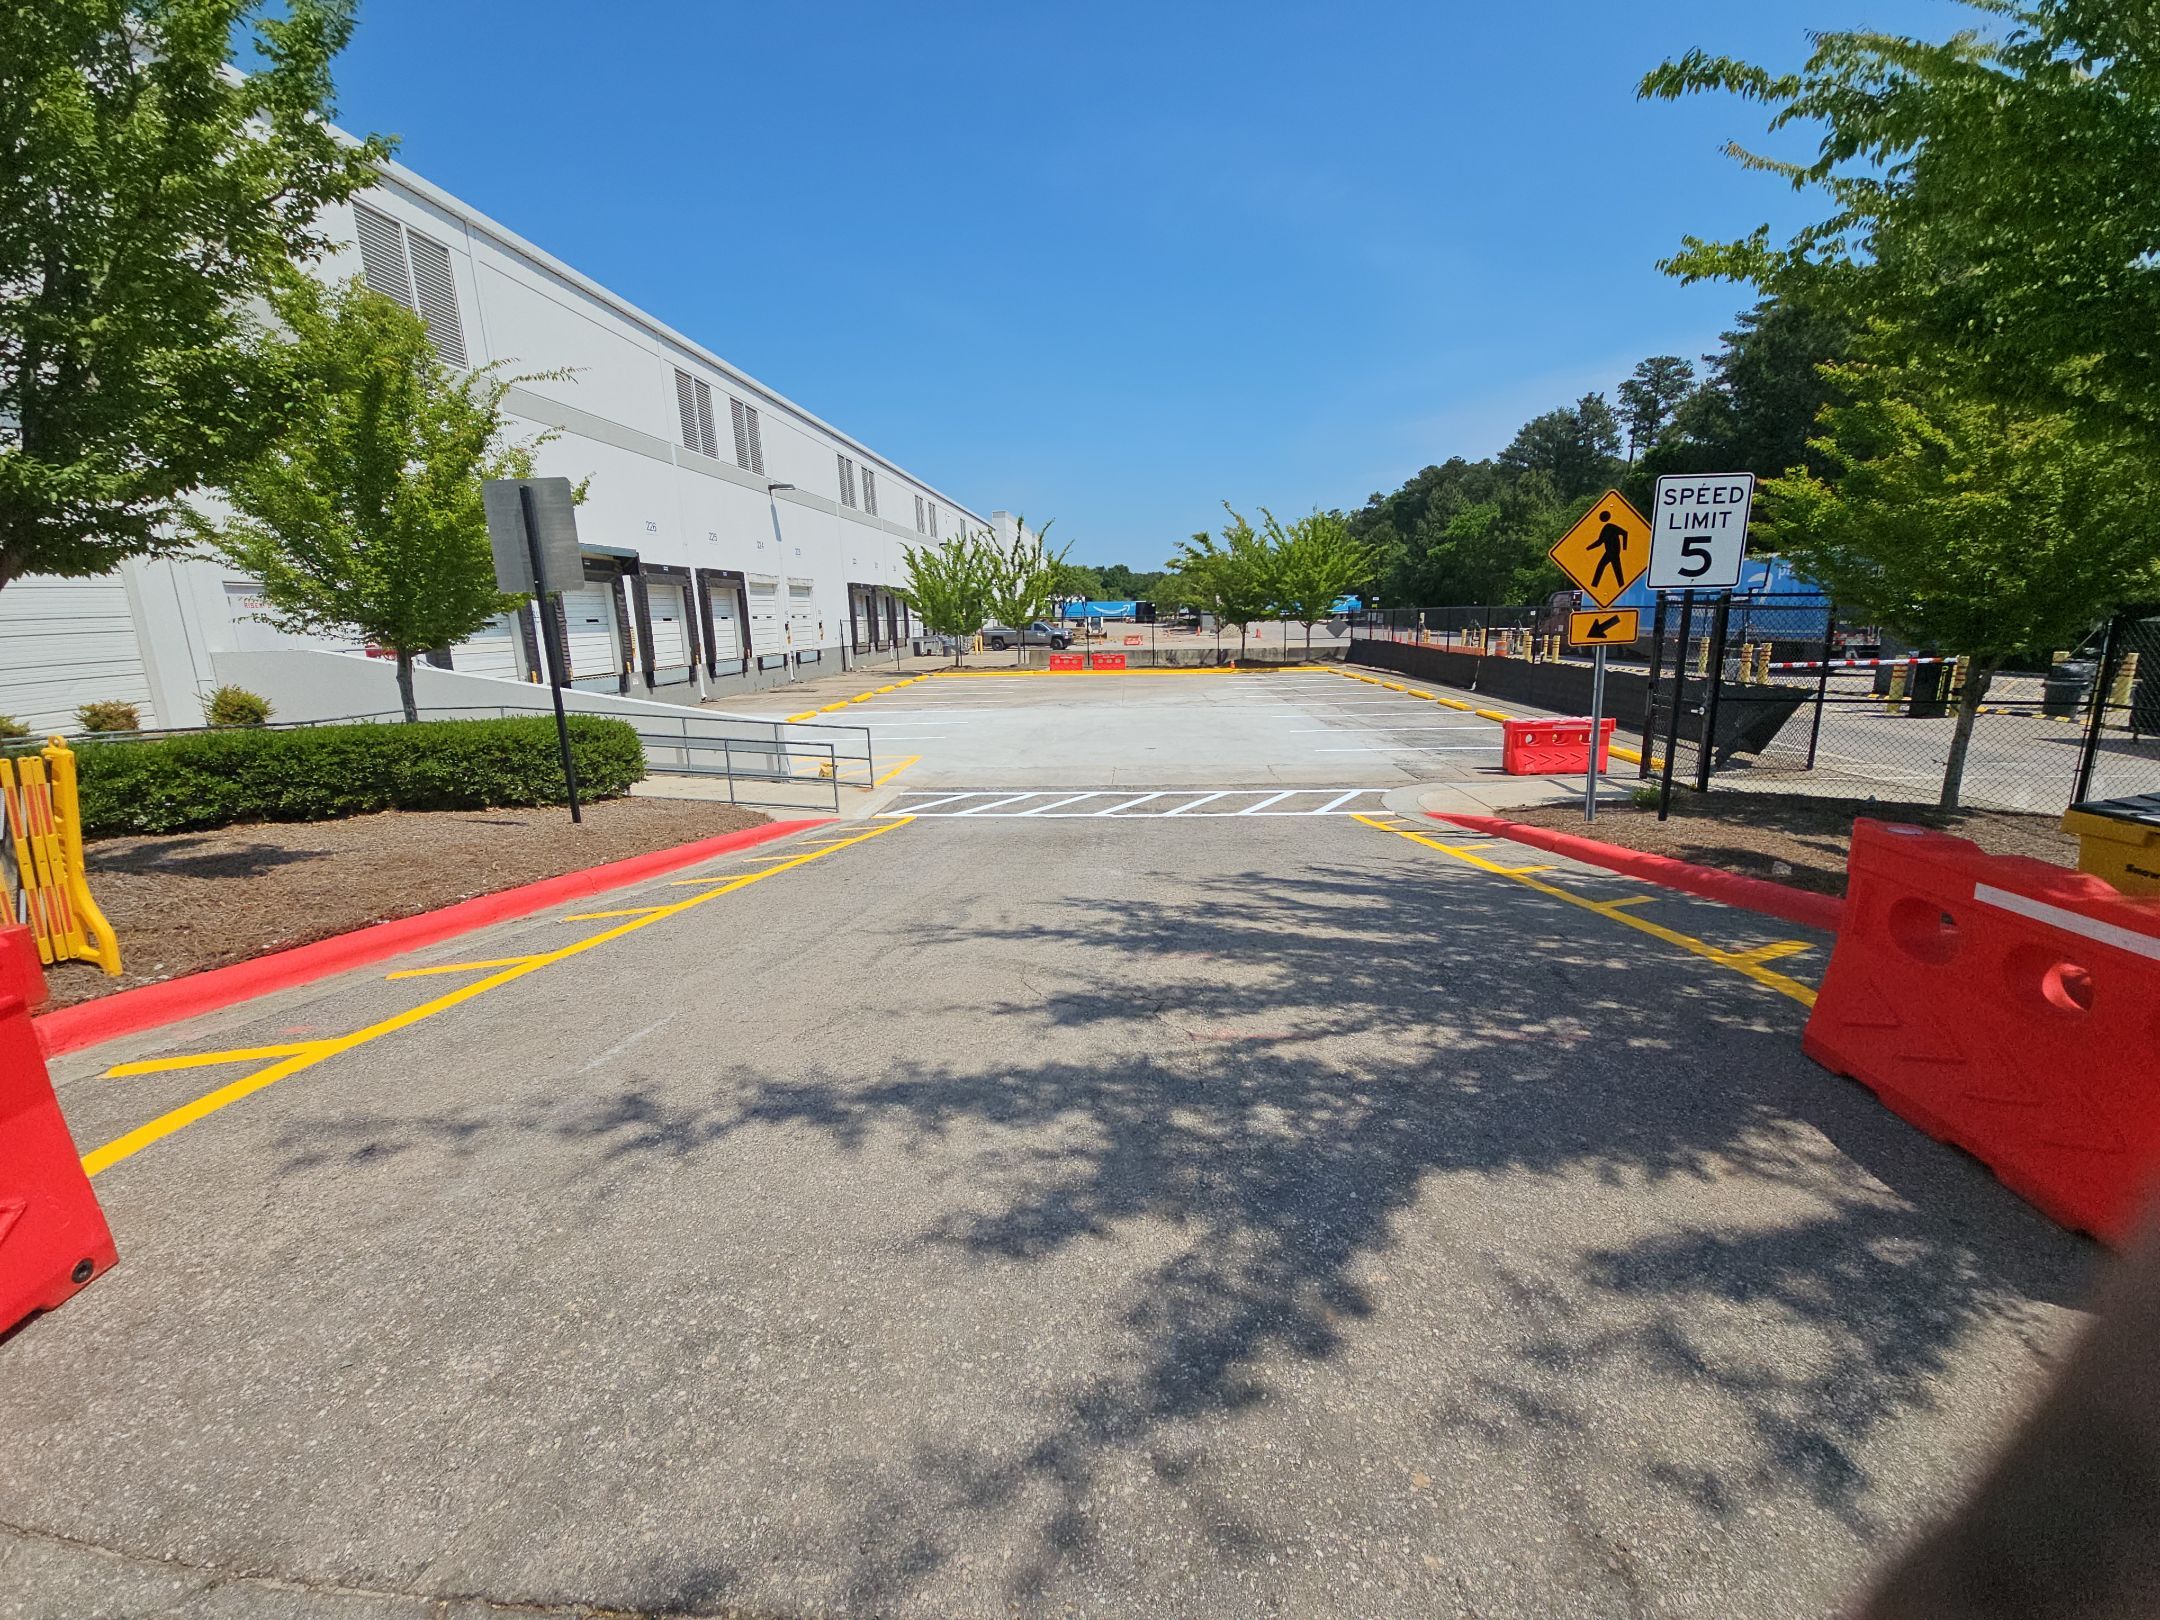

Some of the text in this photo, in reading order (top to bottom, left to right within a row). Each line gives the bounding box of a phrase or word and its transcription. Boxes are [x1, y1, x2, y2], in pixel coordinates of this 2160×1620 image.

[1663, 486, 1744, 506] SPEED
[1669, 511, 1732, 530] LIMIT
[1678, 535, 1713, 578] 5
